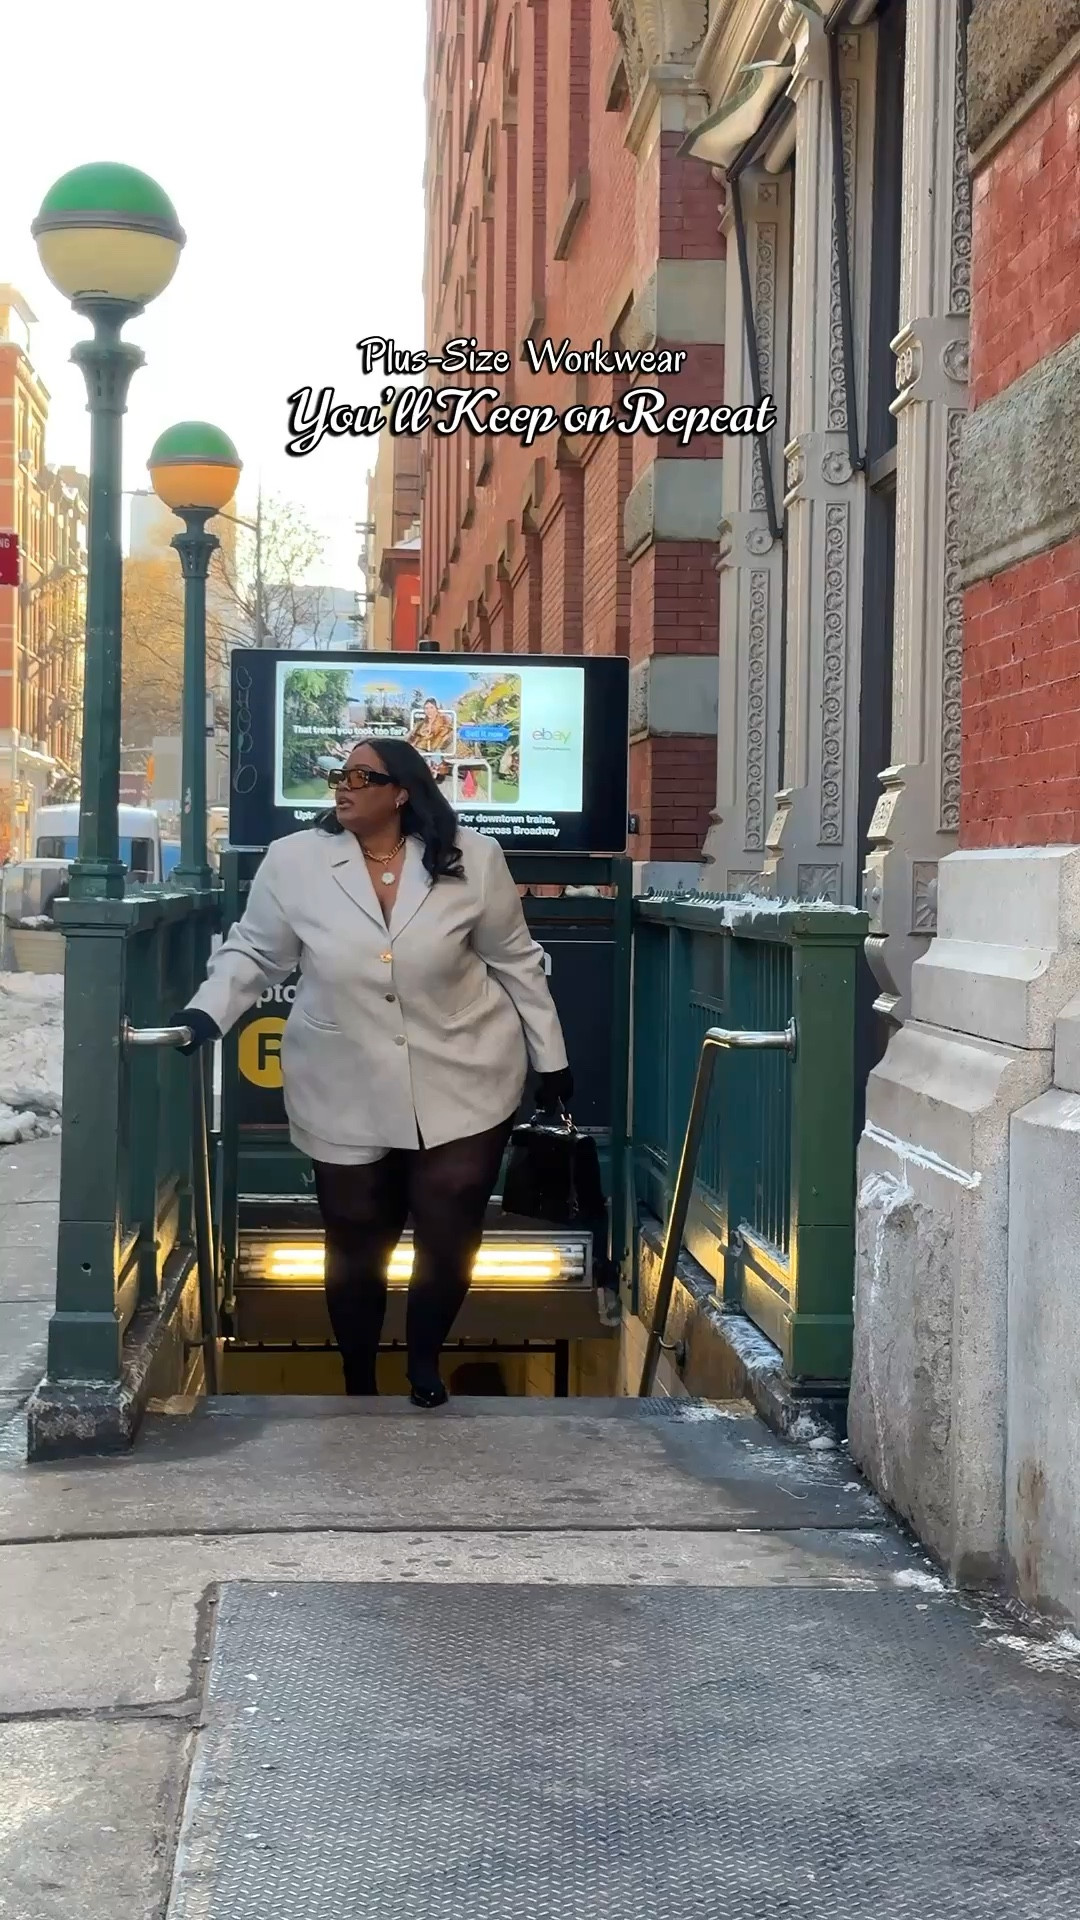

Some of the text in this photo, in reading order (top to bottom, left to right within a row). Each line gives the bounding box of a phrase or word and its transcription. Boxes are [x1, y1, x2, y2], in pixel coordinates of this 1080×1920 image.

[292, 725, 408, 736] That trend you took too far?
[532, 727, 572, 744] ebay
[458, 813, 556, 825] For downtown trains,
[479, 826, 512, 835] across
[513, 826, 561, 837] Broadway
